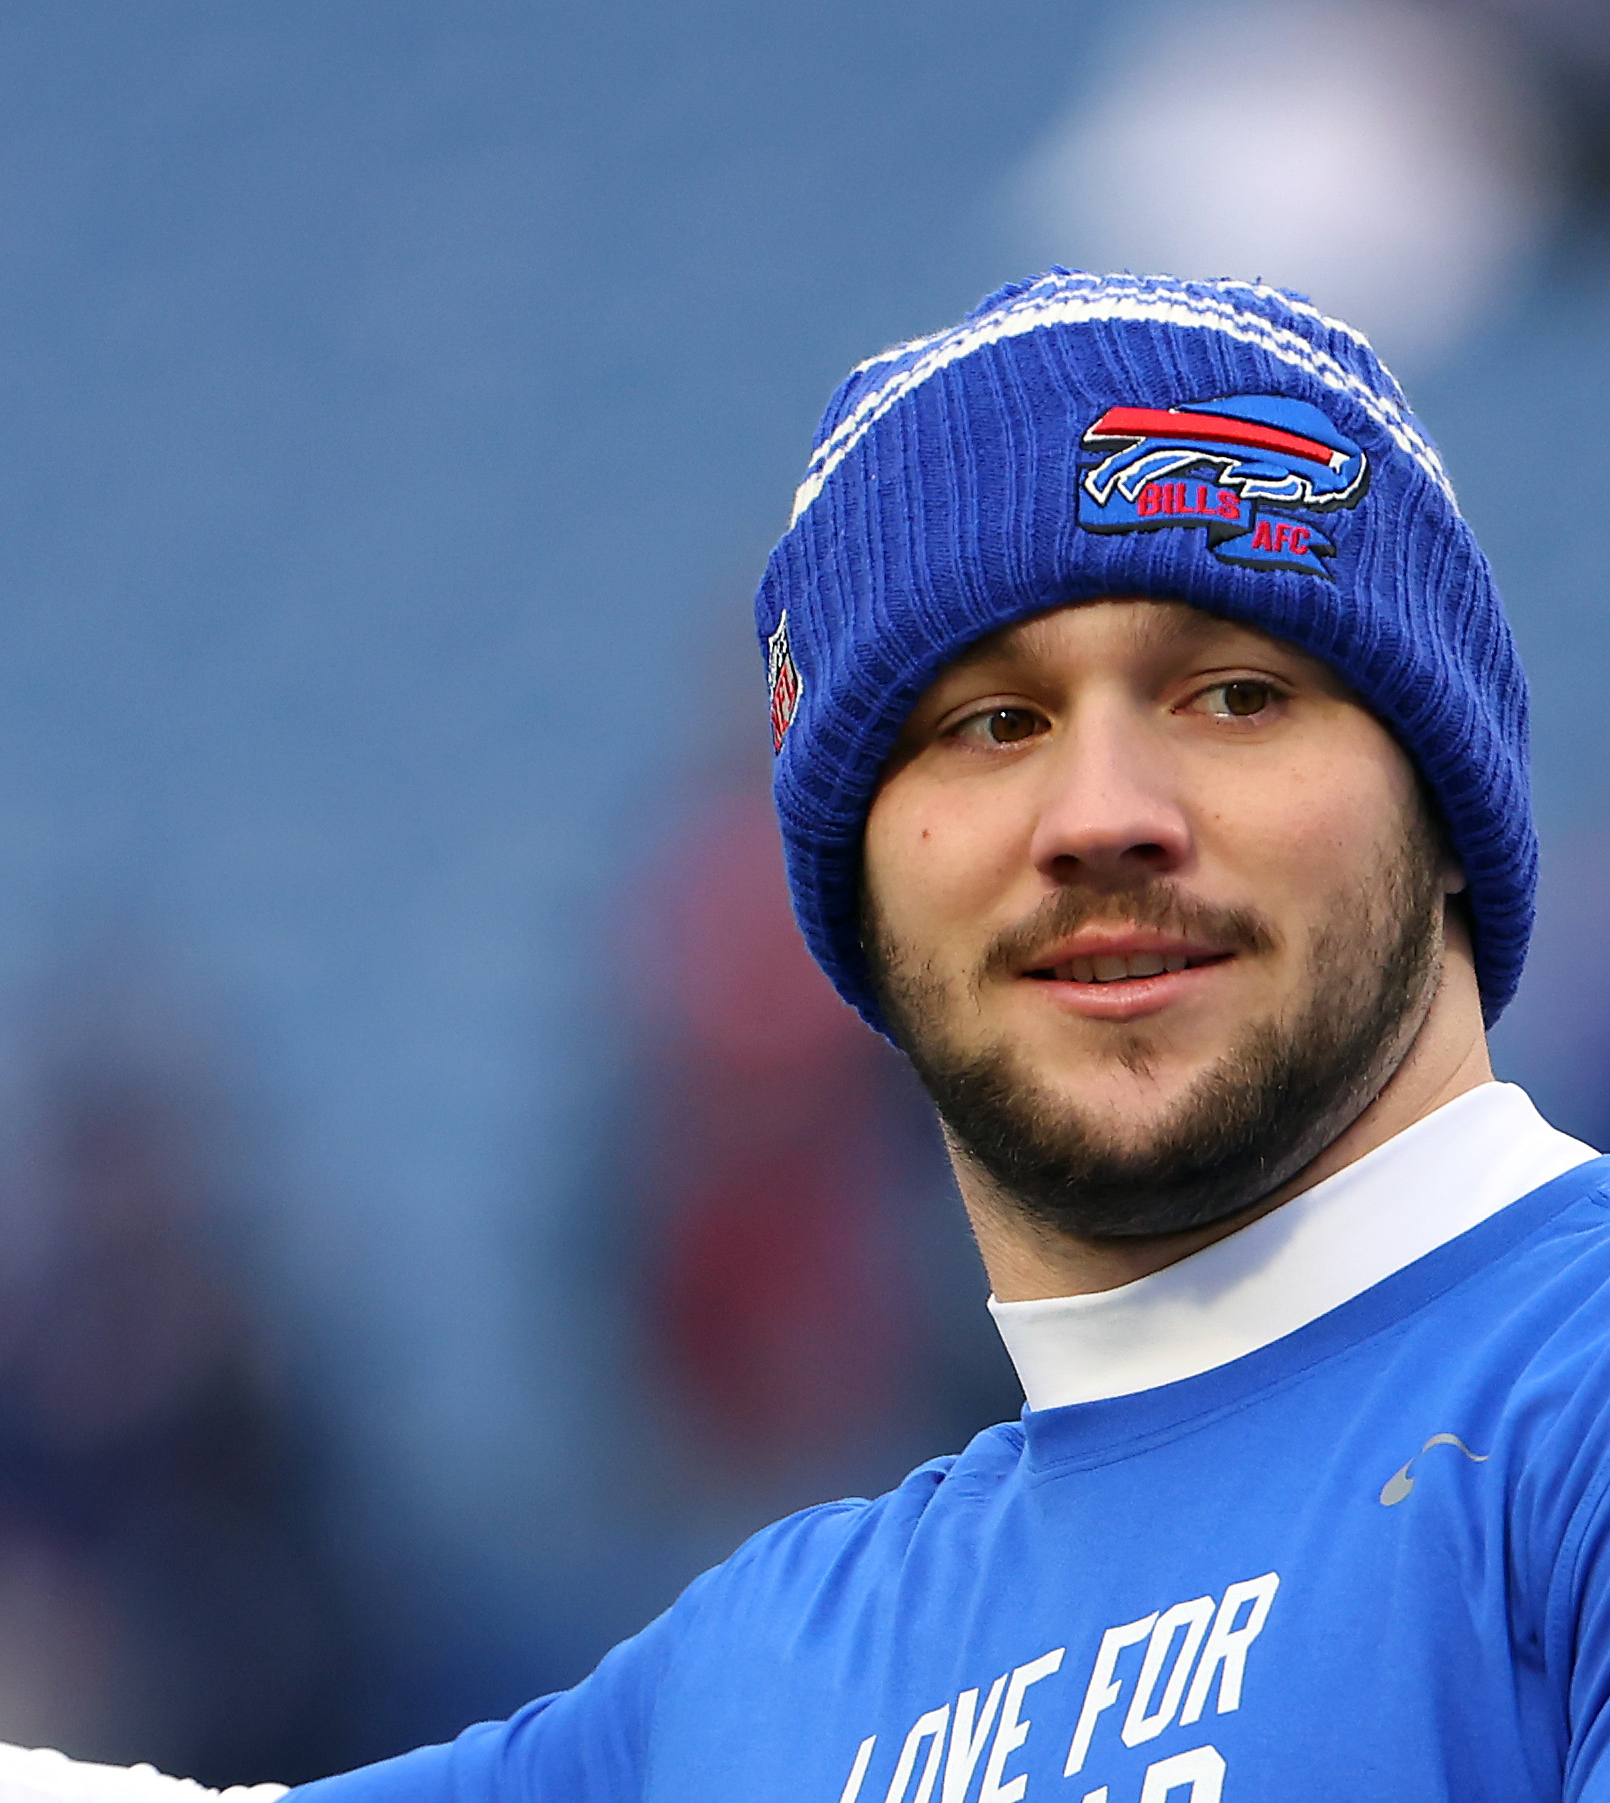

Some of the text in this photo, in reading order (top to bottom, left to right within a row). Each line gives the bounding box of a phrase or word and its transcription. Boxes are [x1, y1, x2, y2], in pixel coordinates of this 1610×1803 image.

[1137, 482, 1241, 519] BILLS
[1251, 521, 1311, 555] AFC
[1063, 1571, 1281, 1779] FOR
